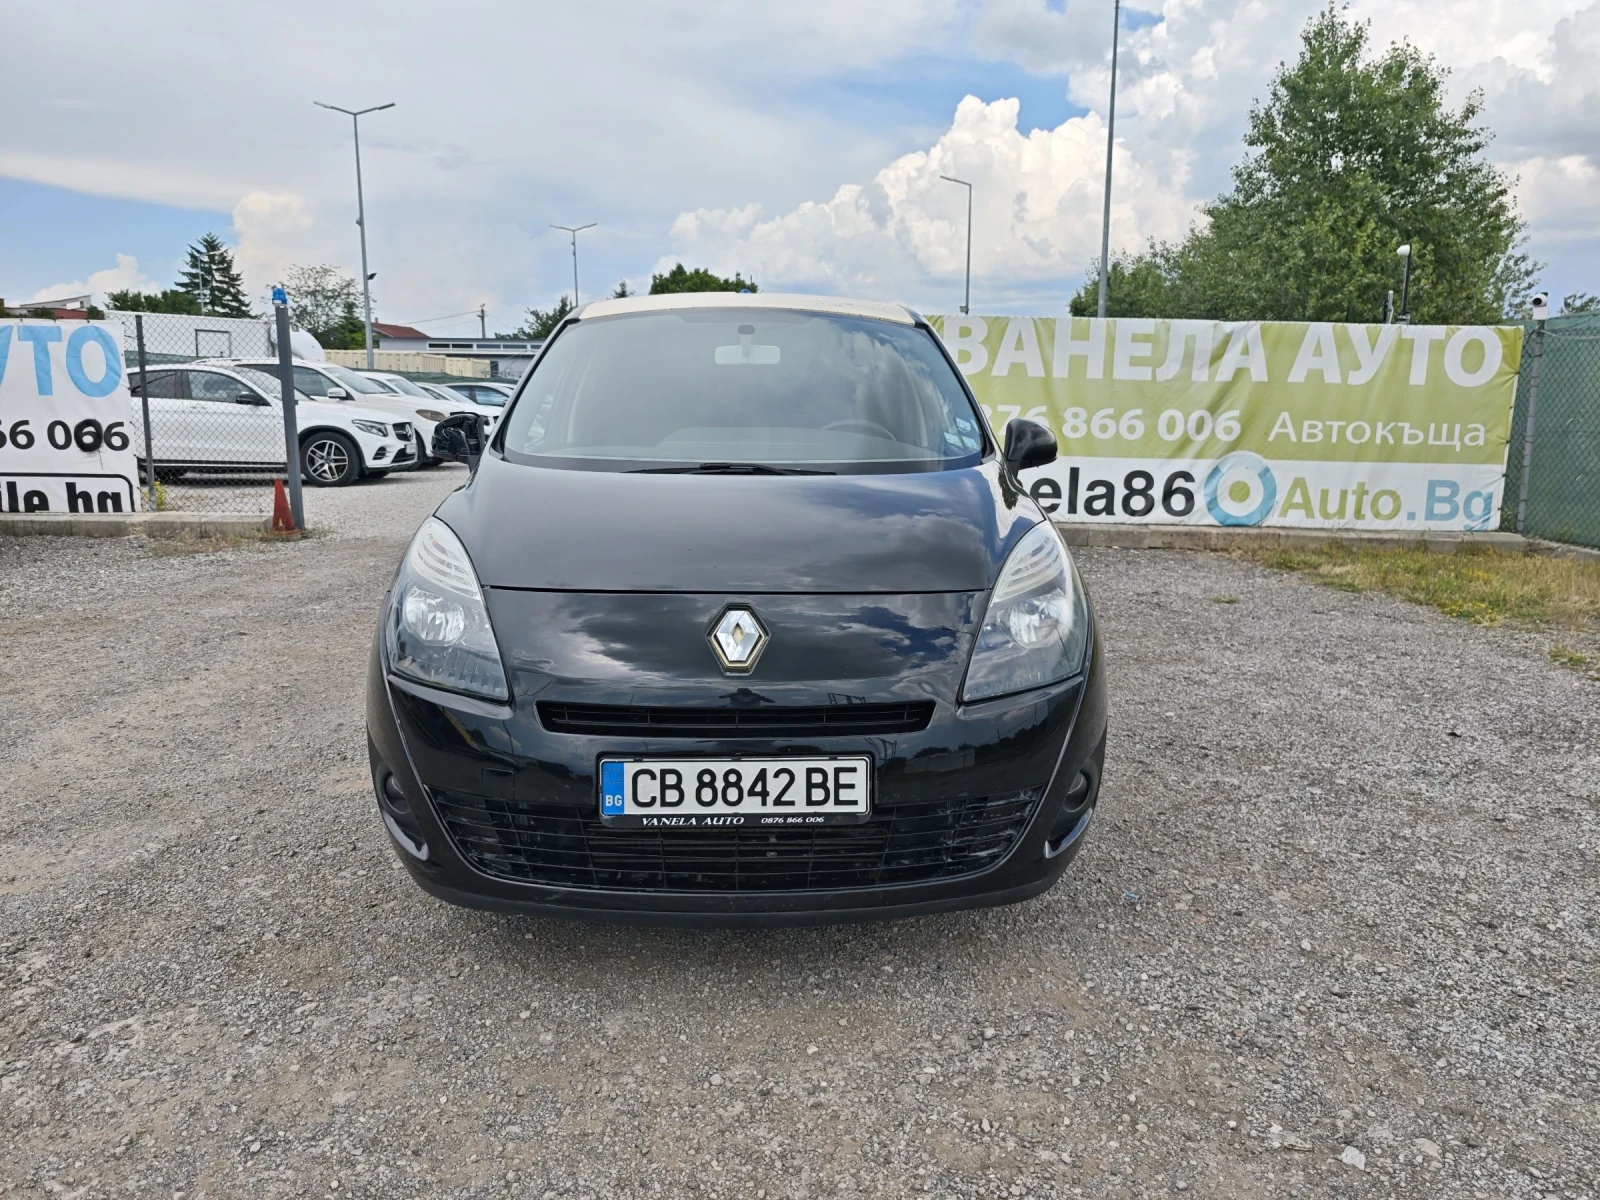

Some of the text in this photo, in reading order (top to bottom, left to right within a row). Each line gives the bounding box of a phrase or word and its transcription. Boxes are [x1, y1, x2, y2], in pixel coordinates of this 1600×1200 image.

[0, 325, 122, 398] ТО
[942, 316, 1503, 388] ВАНЕЛА АУТО
[0, 419, 36, 451] 6
[1062, 406, 1145, 441] 866
[1157, 408, 1241, 442] 006
[1267, 411, 1486, 452] Автокъща
[1018, 466, 1494, 532] ela86 Auto.Bg
[605, 795, 623, 806] BG
[631, 766, 859, 807] CB 8842 BE
[641, 815, 826, 827] VANELA AUTO 0876 866 006
